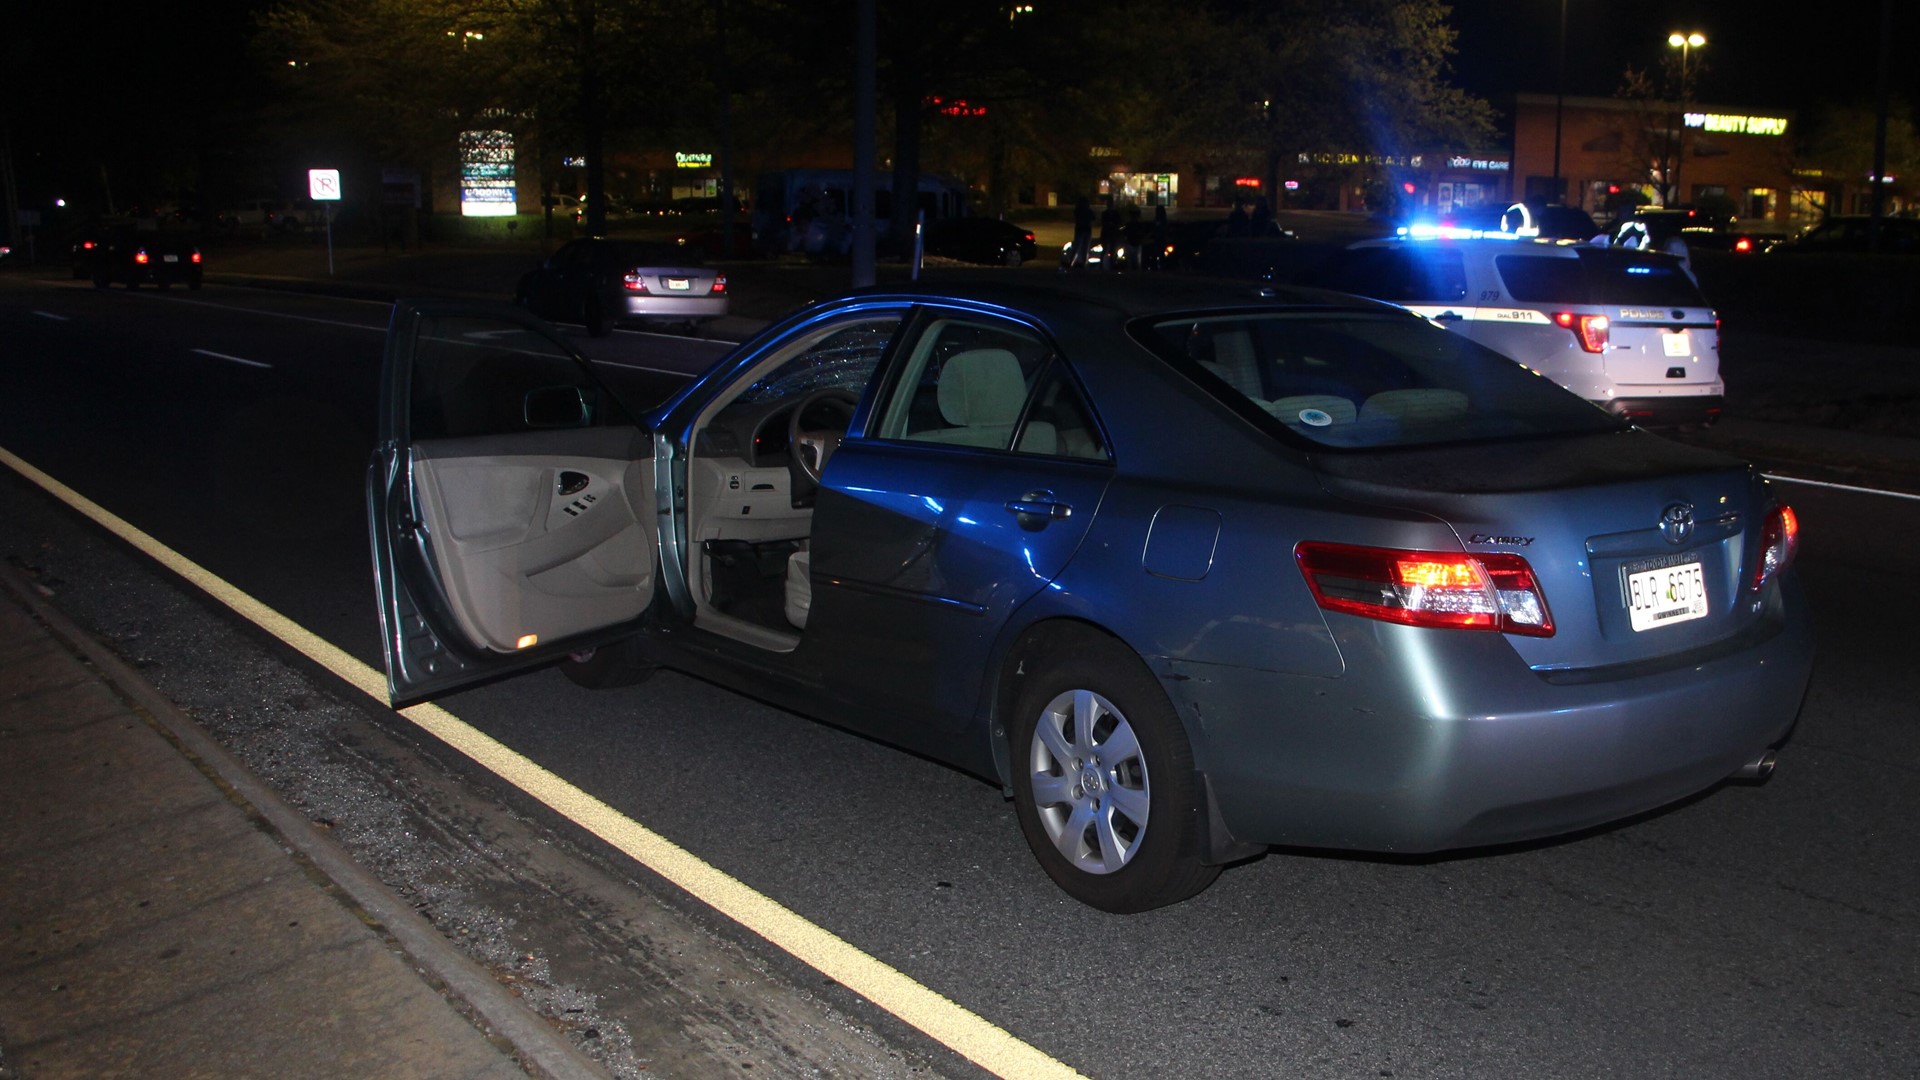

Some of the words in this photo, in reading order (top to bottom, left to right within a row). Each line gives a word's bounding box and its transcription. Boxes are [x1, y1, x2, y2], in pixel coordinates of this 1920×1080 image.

[1684, 113, 1705, 127] TOP
[1704, 114, 1747, 132] BEAUTY
[1747, 116, 1787, 135] SUPPLY
[1313, 153, 1359, 164] GODEN
[1472, 160, 1487, 170] EYE
[1488, 160, 1509, 171] CARE
[1480, 290, 1500, 301] 979
[1512, 311, 1533, 320] 911
[1620, 308, 1665, 320] POLICE
[1632, 576, 1660, 611] BLR
[1668, 567, 1703, 603] 6675
